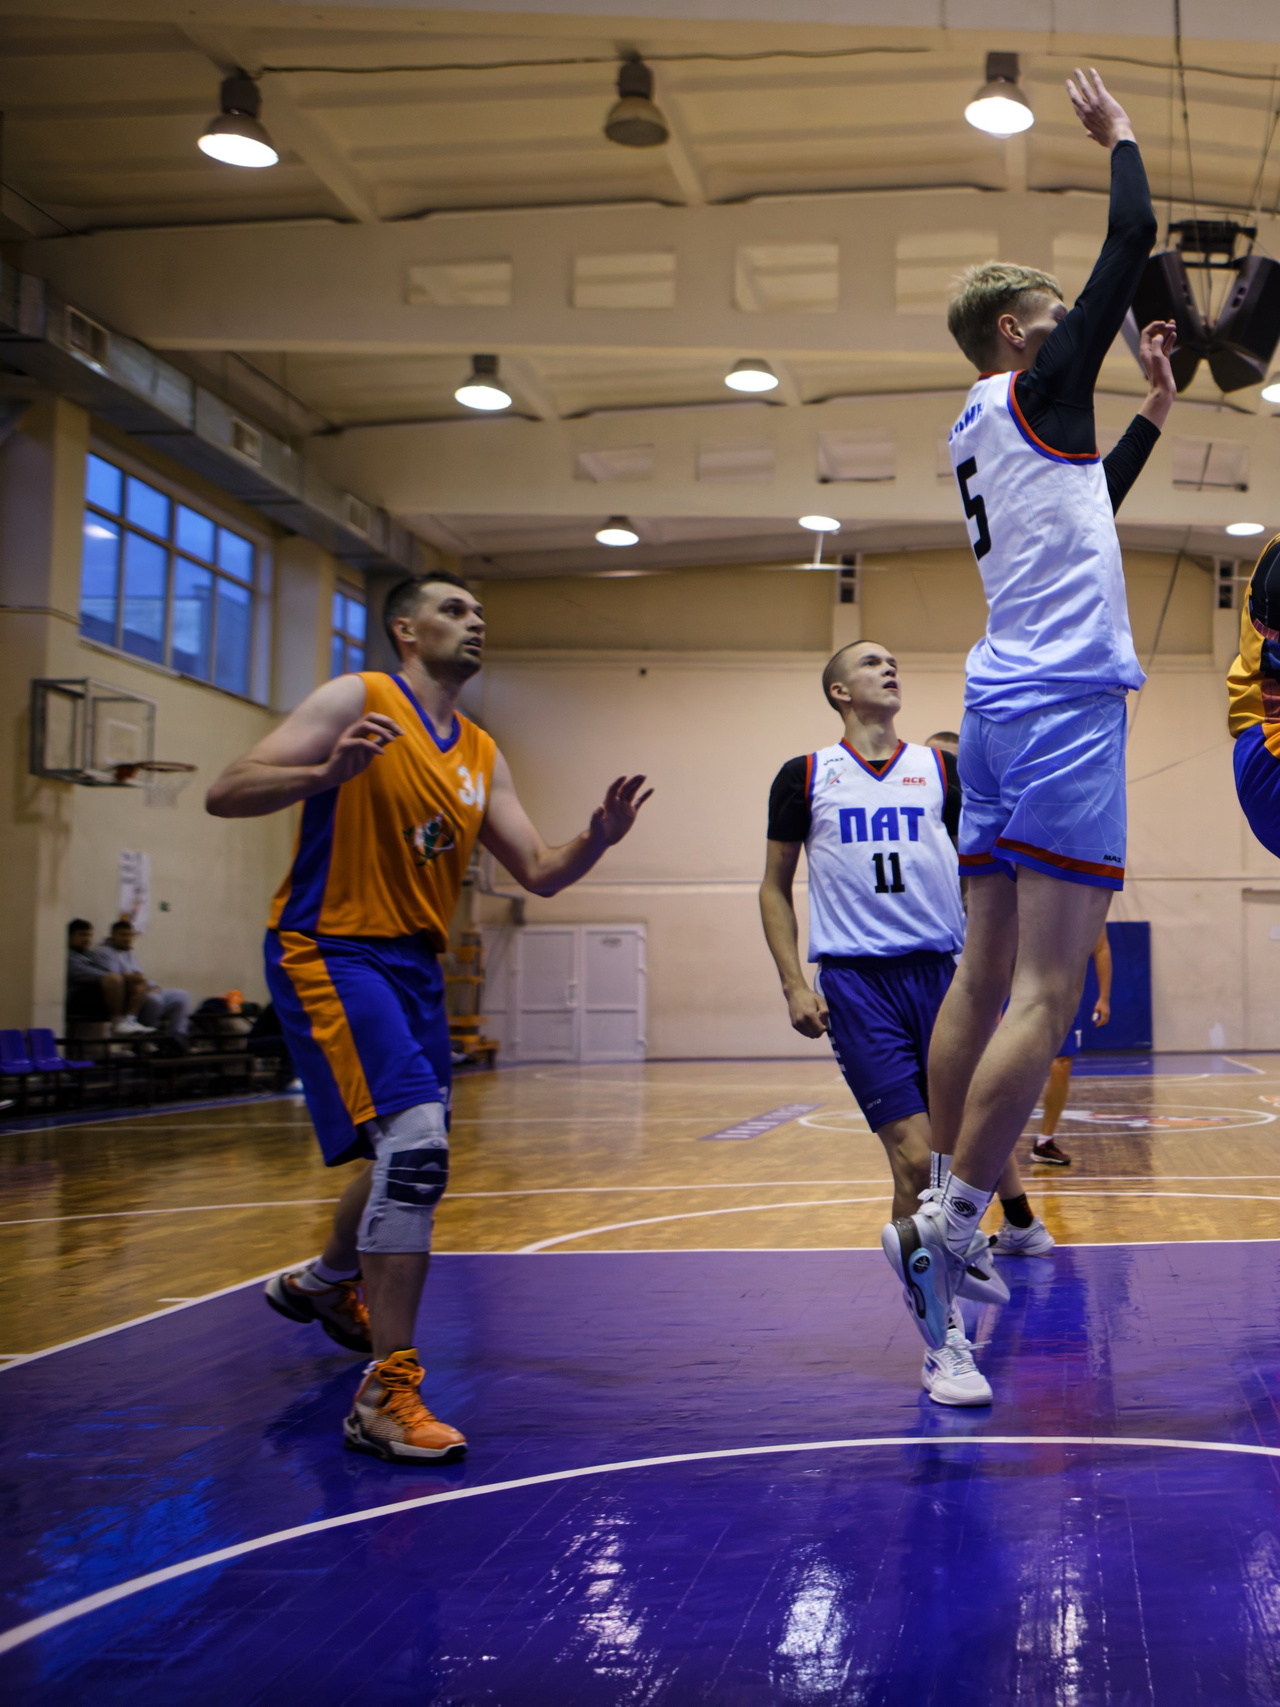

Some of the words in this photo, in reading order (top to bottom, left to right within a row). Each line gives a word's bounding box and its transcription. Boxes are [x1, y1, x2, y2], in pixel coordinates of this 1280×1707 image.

[957, 456, 991, 561] 5
[457, 765, 486, 811] 34
[839, 807, 925, 844] ПАТ
[872, 852, 905, 893] 11
